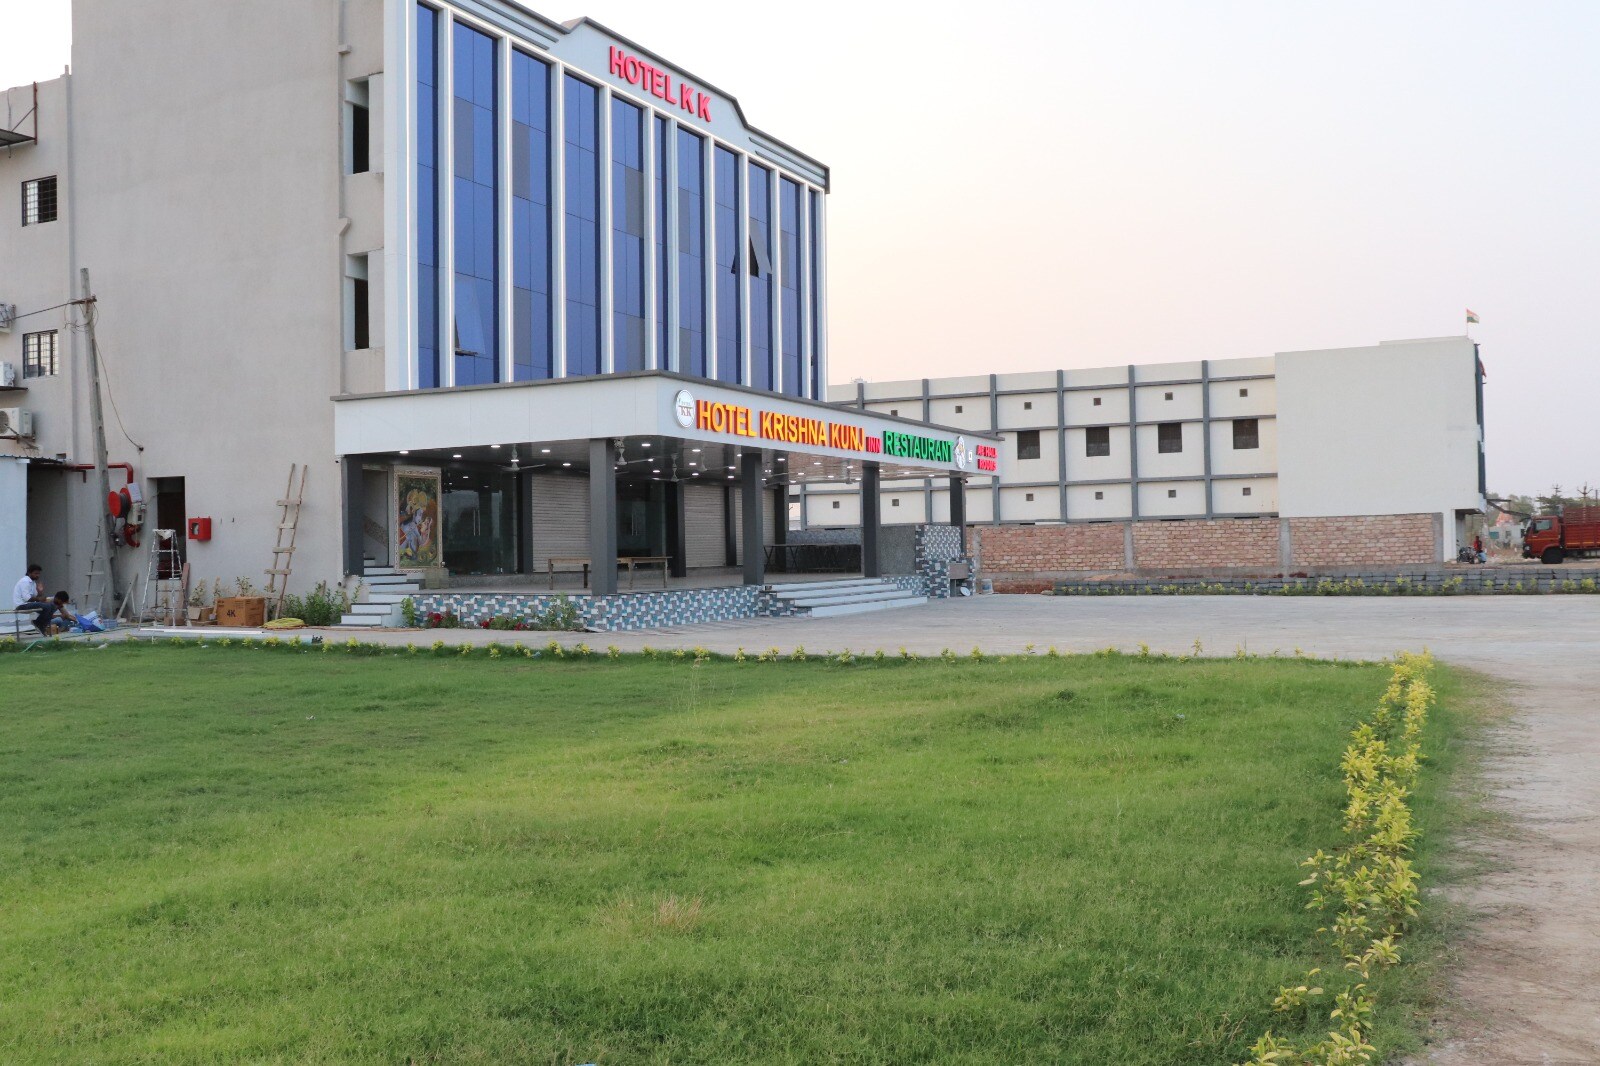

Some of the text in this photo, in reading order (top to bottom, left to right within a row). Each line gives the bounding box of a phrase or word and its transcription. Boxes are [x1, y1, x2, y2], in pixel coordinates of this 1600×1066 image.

[610, 46, 711, 122] HOTEL K K
[696, 399, 954, 463] HOTEL KRISHNA KUNJ INN RESTAURANT
